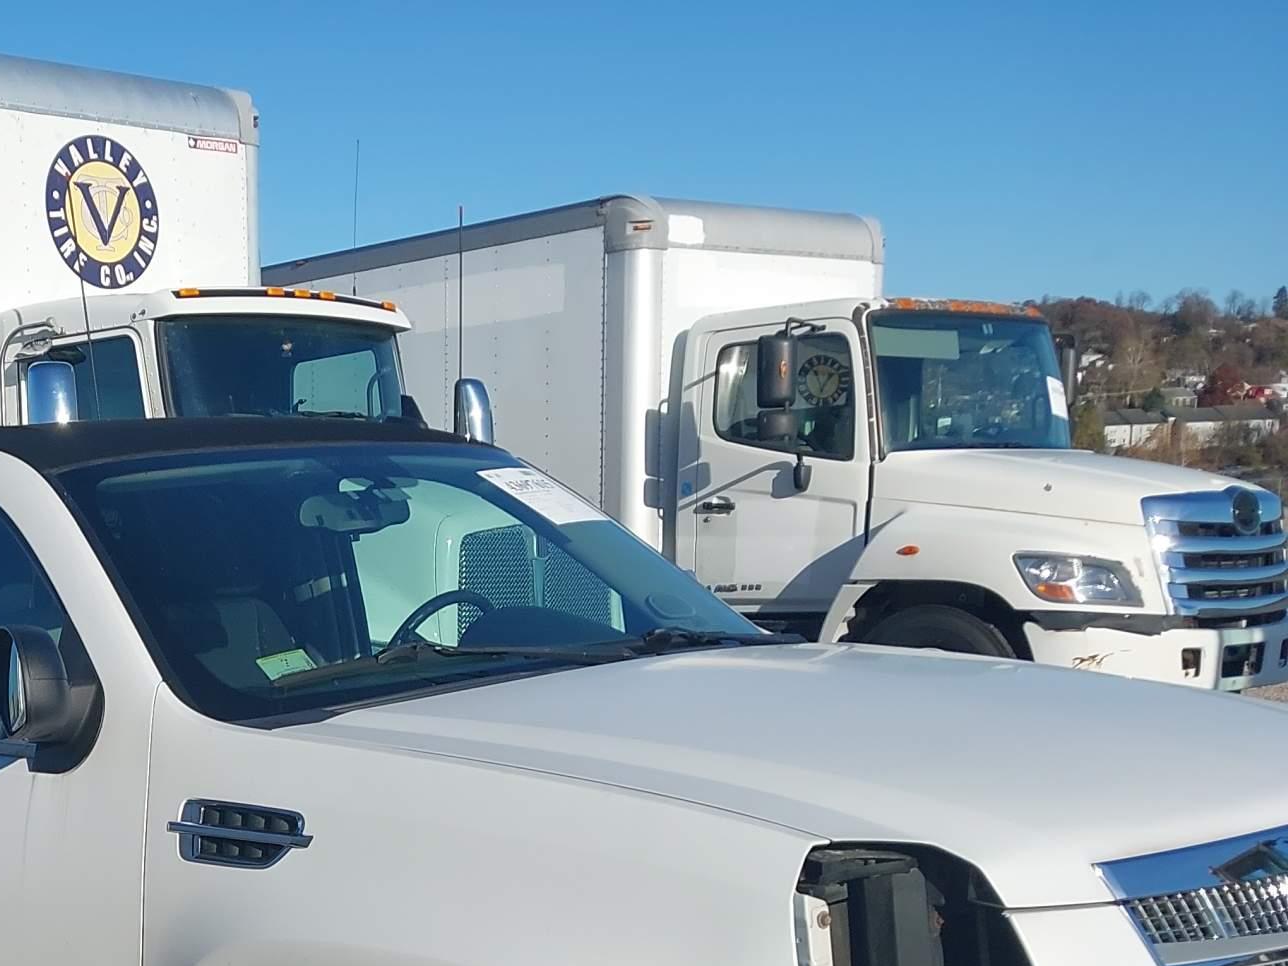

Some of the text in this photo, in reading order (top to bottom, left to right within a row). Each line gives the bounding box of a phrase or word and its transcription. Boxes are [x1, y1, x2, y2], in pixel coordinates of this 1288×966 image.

[53, 138, 148, 187] VALLEY
[49, 208, 88, 273] TIRE
[72, 181, 131, 246] V
